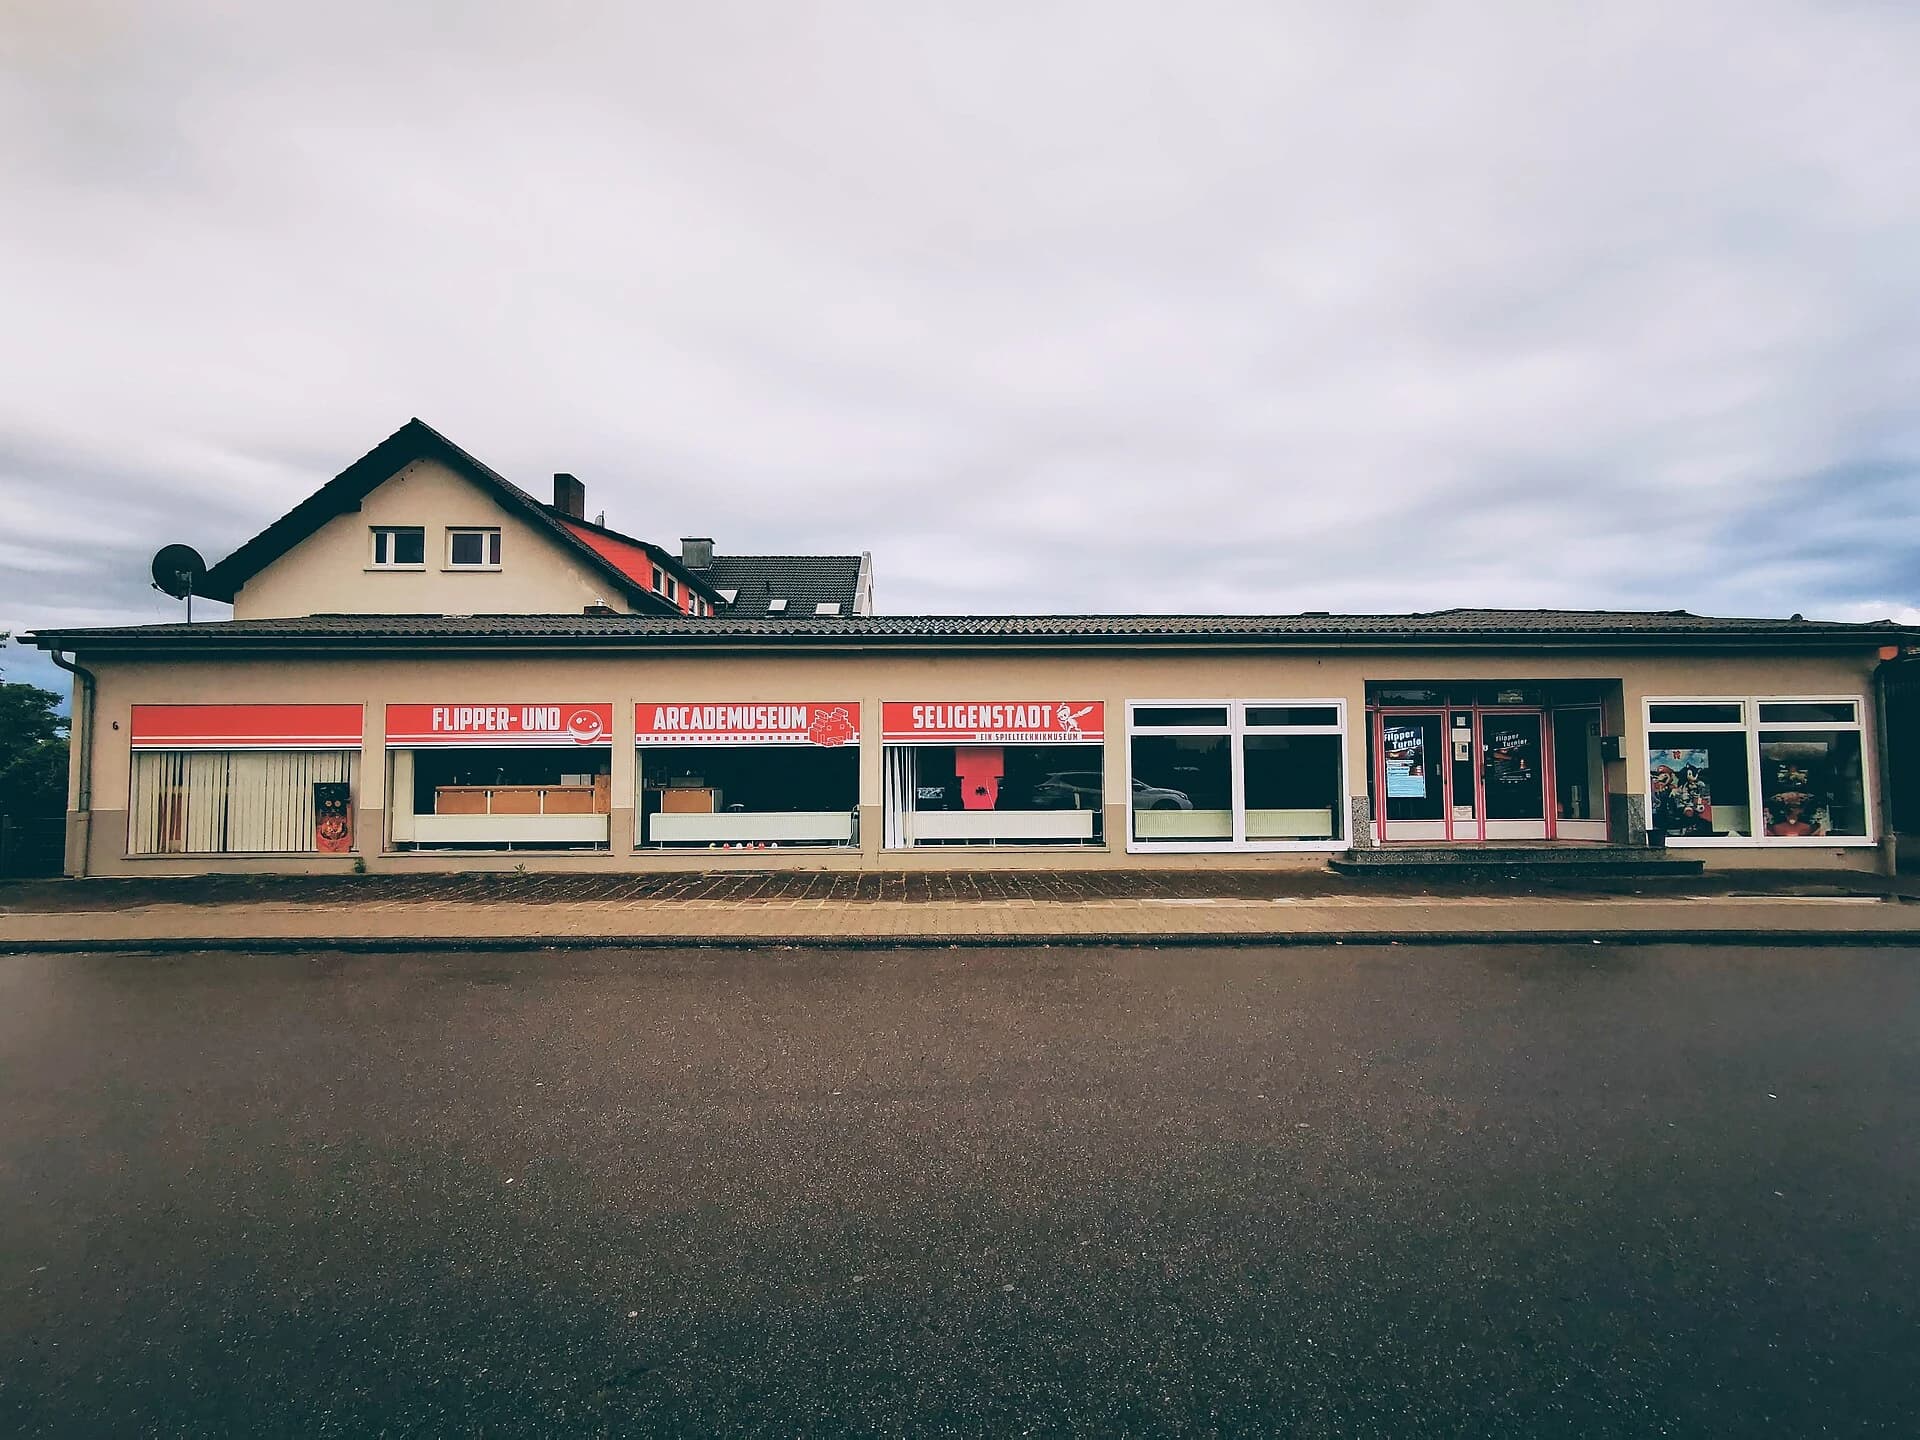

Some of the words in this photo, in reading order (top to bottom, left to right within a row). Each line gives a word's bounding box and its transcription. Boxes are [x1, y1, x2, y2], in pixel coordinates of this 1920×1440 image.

[433, 707, 518, 731] FLIPPER-
[521, 707, 561, 731] UND
[653, 706, 807, 730] ARCADEMUSEUM
[912, 705, 1052, 729] SELIGENSTADT
[995, 733, 1078, 741] SPIELTECHNIKMUSEUM
